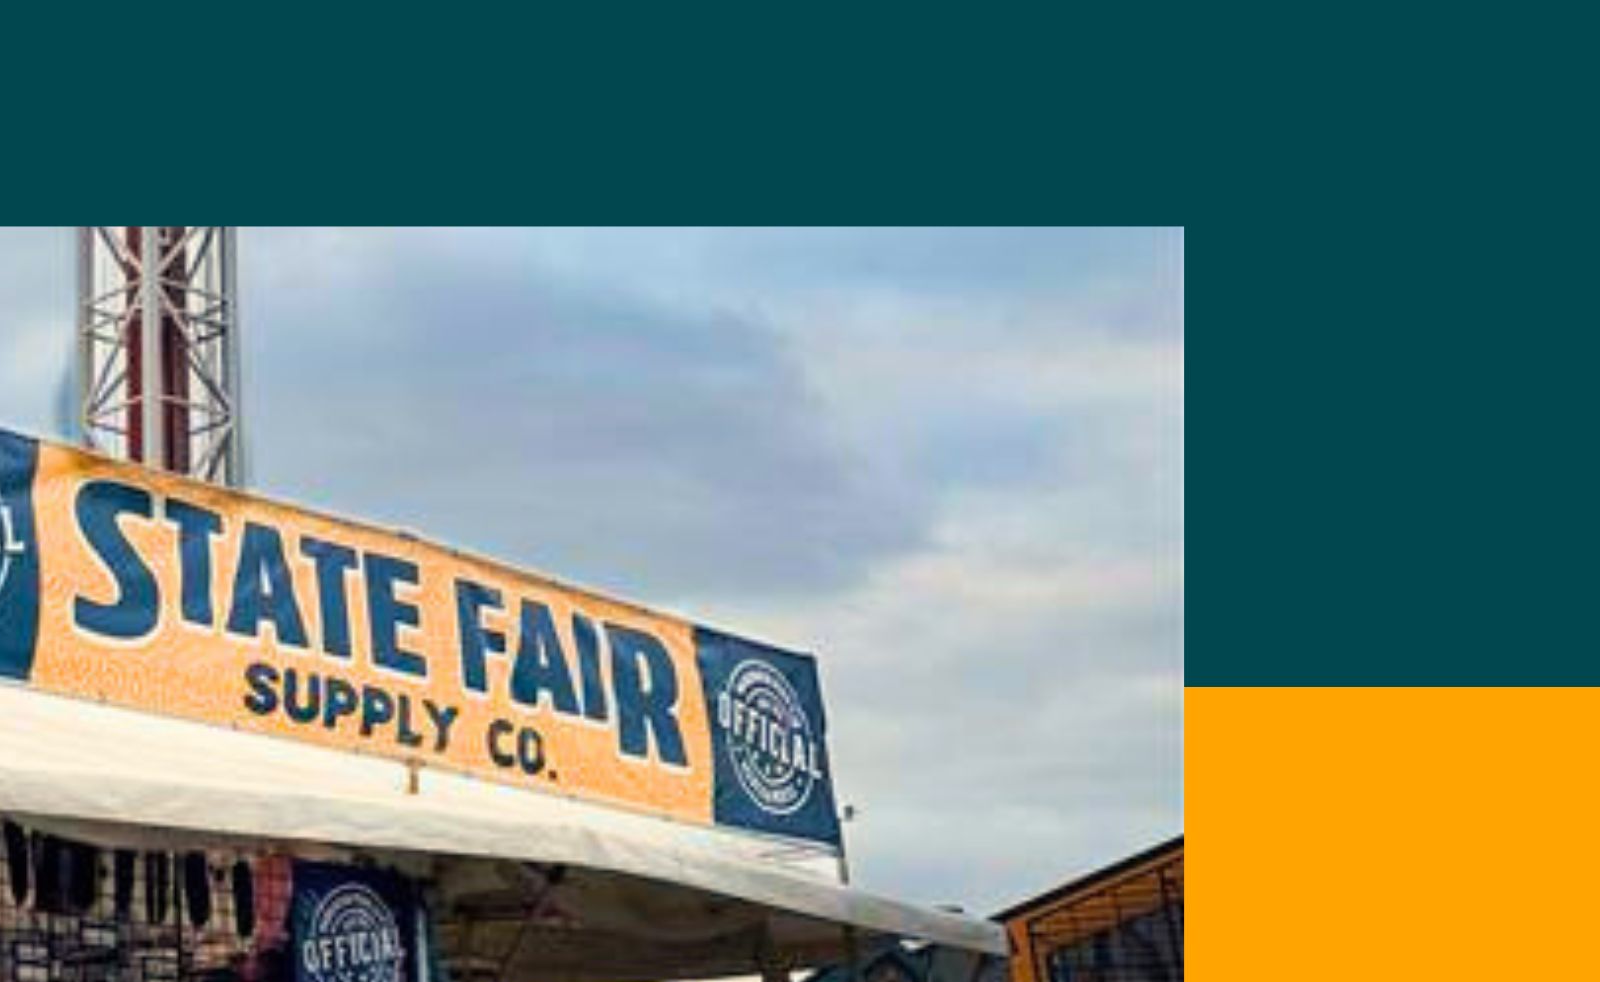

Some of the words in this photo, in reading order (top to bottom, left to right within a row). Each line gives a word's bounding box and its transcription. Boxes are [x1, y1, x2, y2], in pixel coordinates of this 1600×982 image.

[72, 480, 428, 678] STATE
[455, 578, 688, 767] FAIR
[243, 661, 460, 753] SUPPLY
[487, 717, 559, 782] CO.
[717, 690, 824, 780] OFFICIAL
